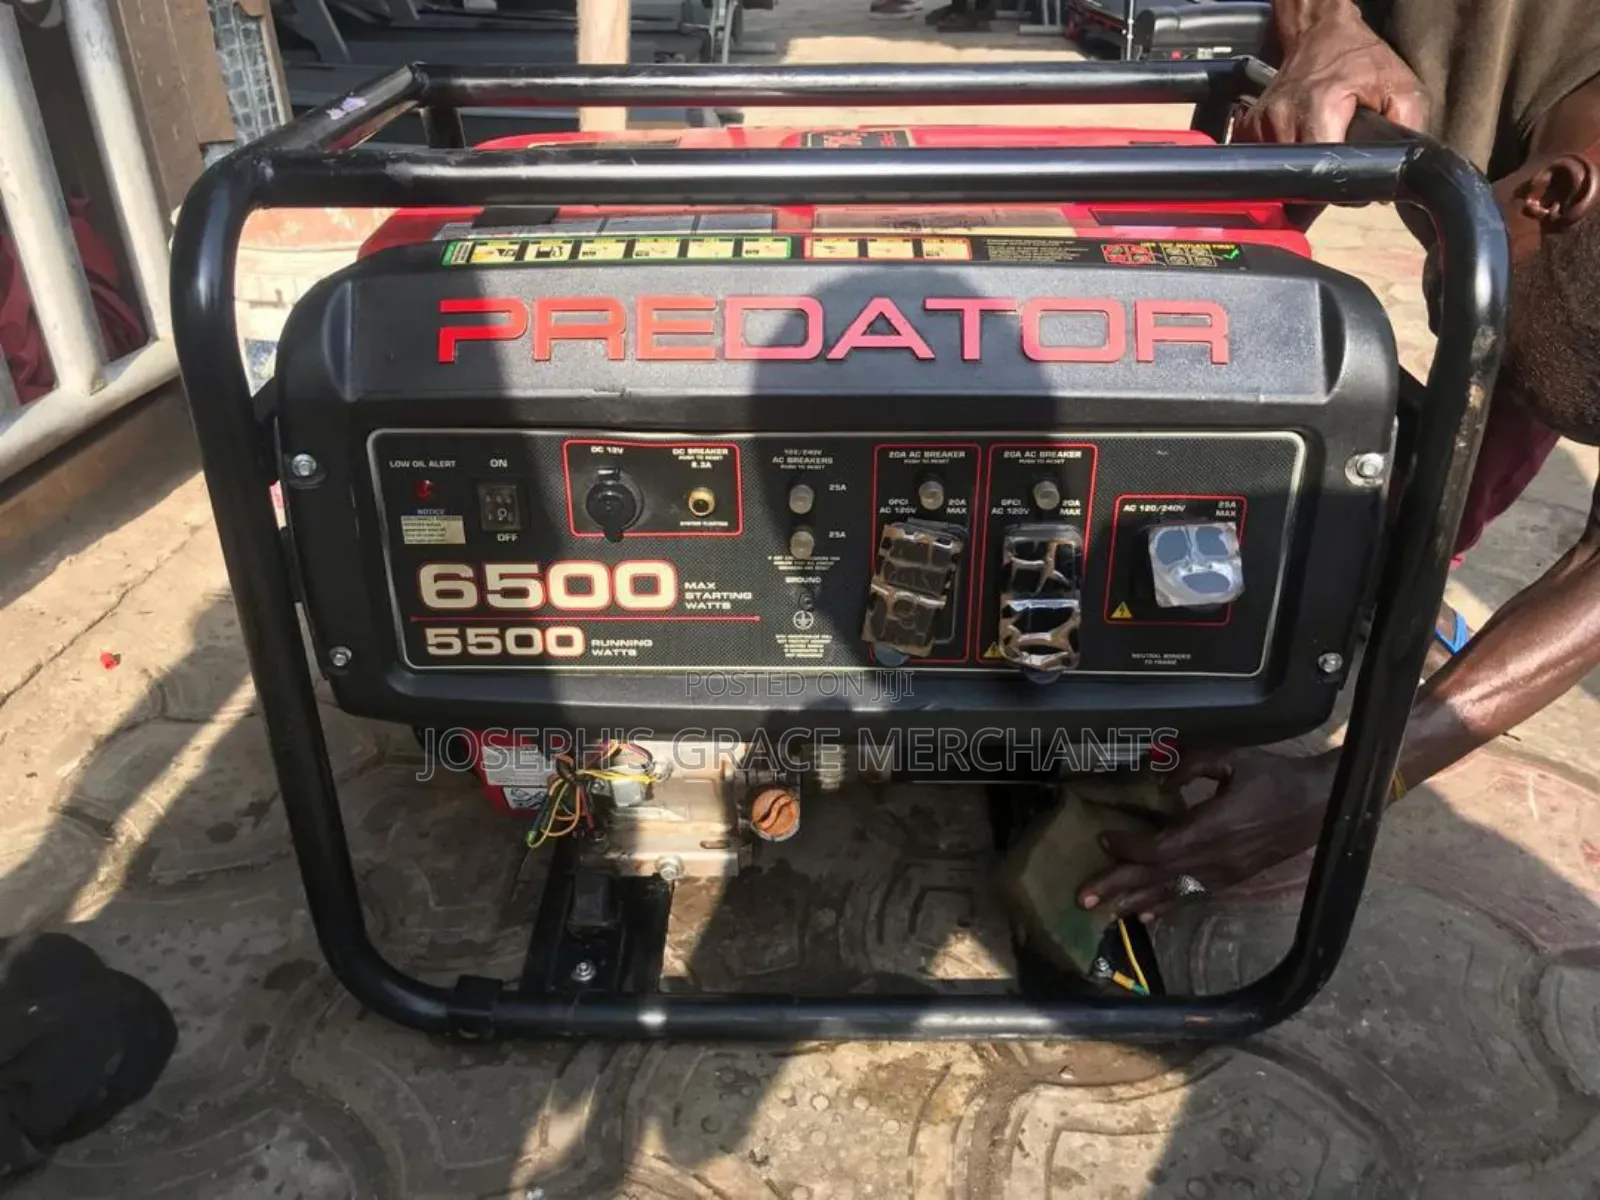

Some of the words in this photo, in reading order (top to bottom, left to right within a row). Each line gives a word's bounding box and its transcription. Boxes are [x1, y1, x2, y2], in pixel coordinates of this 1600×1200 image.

[437, 296, 1231, 365] PREDATOR
[590, 446, 604, 454] DC
[606, 447, 624, 455] 12V
[672, 448, 685, 456] DC
[687, 448, 729, 456] BREAKER
[389, 460, 410, 468] LOW
[412, 460, 426, 468] OIL
[428, 460, 456, 468] ALERT
[489, 458, 508, 468] ON
[787, 457, 834, 465] BREAKERS
[991, 507, 1004, 515] AC
[1059, 507, 1081, 515] MAX
[1123, 504, 1136, 512] AC
[1139, 504, 1186, 513] 120/240V
[497, 533, 518, 542] OFF
[829, 531, 846, 539] 25A
[418, 559, 679, 612] 6500
[684, 581, 716, 590] MAX
[684, 592, 752, 600] STARTING
[684, 602, 732, 610] WATTS
[423, 626, 586, 658] 5500
[591, 639, 653, 648] RUNNING
[592, 649, 637, 657] WATTS
